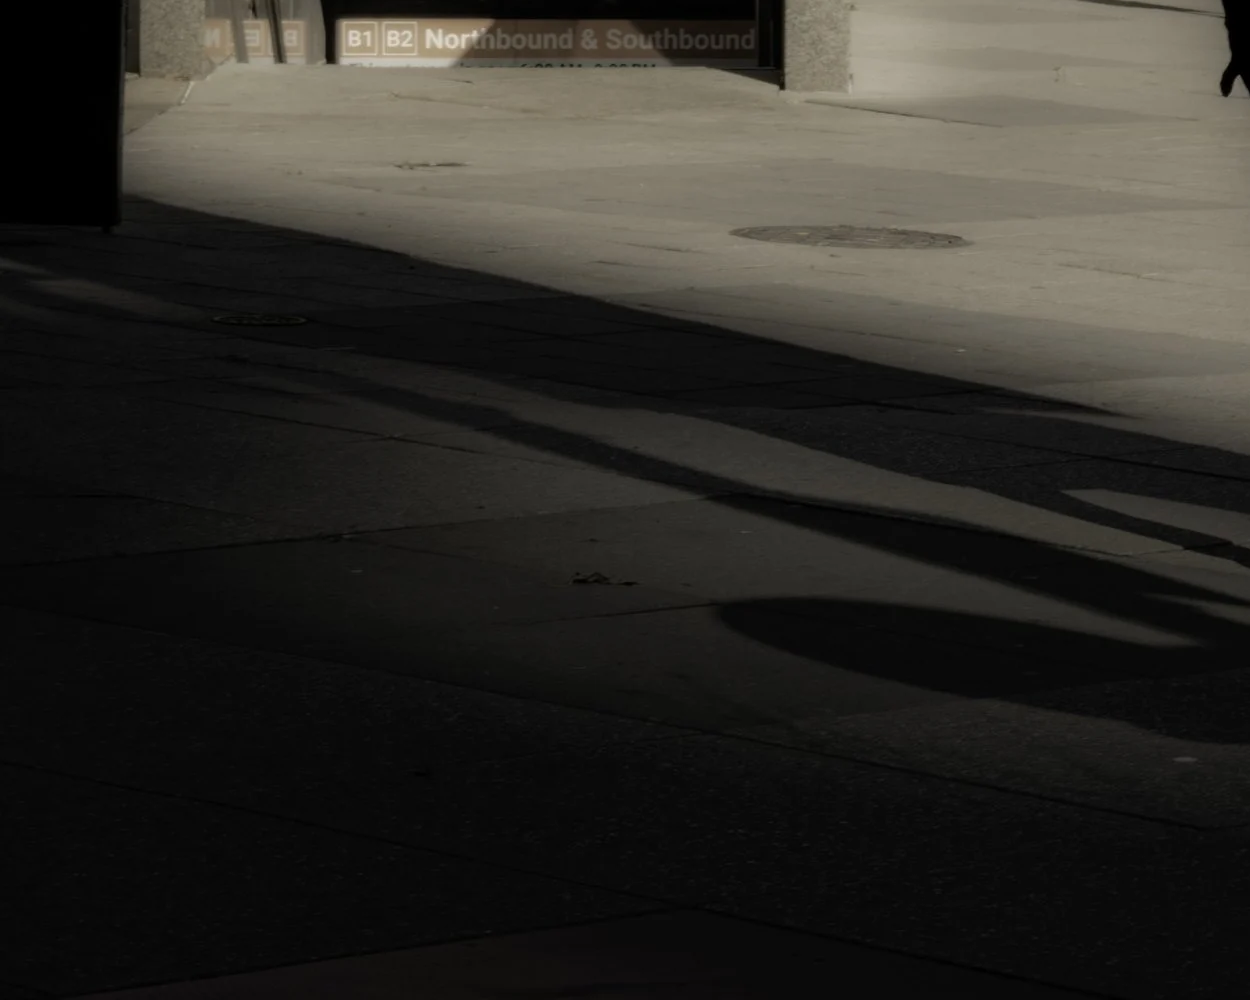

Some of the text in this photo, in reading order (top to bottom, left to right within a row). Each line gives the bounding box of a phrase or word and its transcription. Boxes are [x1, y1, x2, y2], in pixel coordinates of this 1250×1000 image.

[346, 27, 756, 51] B1 B2 Northbound & Southbound
